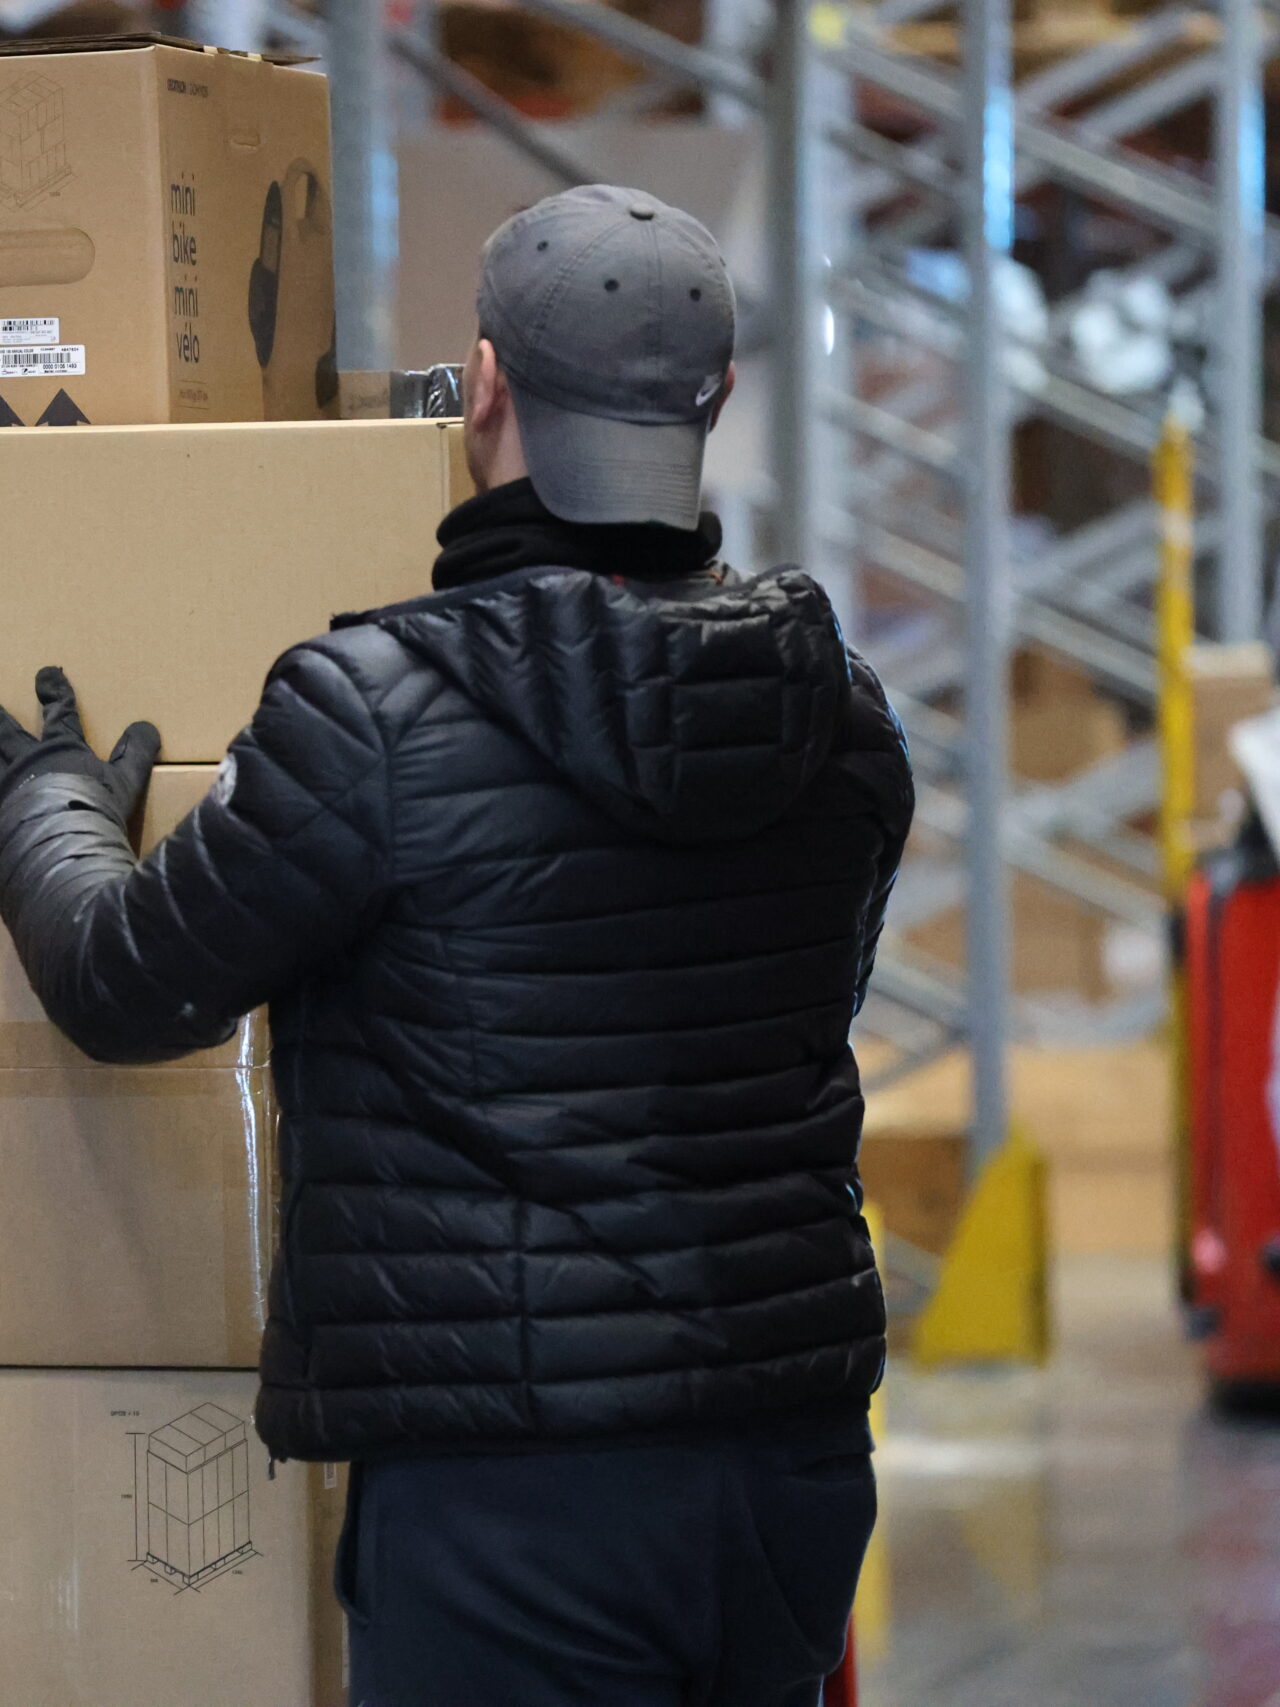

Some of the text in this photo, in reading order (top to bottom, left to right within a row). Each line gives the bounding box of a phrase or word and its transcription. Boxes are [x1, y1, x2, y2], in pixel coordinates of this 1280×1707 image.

[171, 171, 195, 216] mini
[172, 220, 197, 266] bike
[174, 274, 199, 317] mini
[176, 321, 200, 363] vélo
